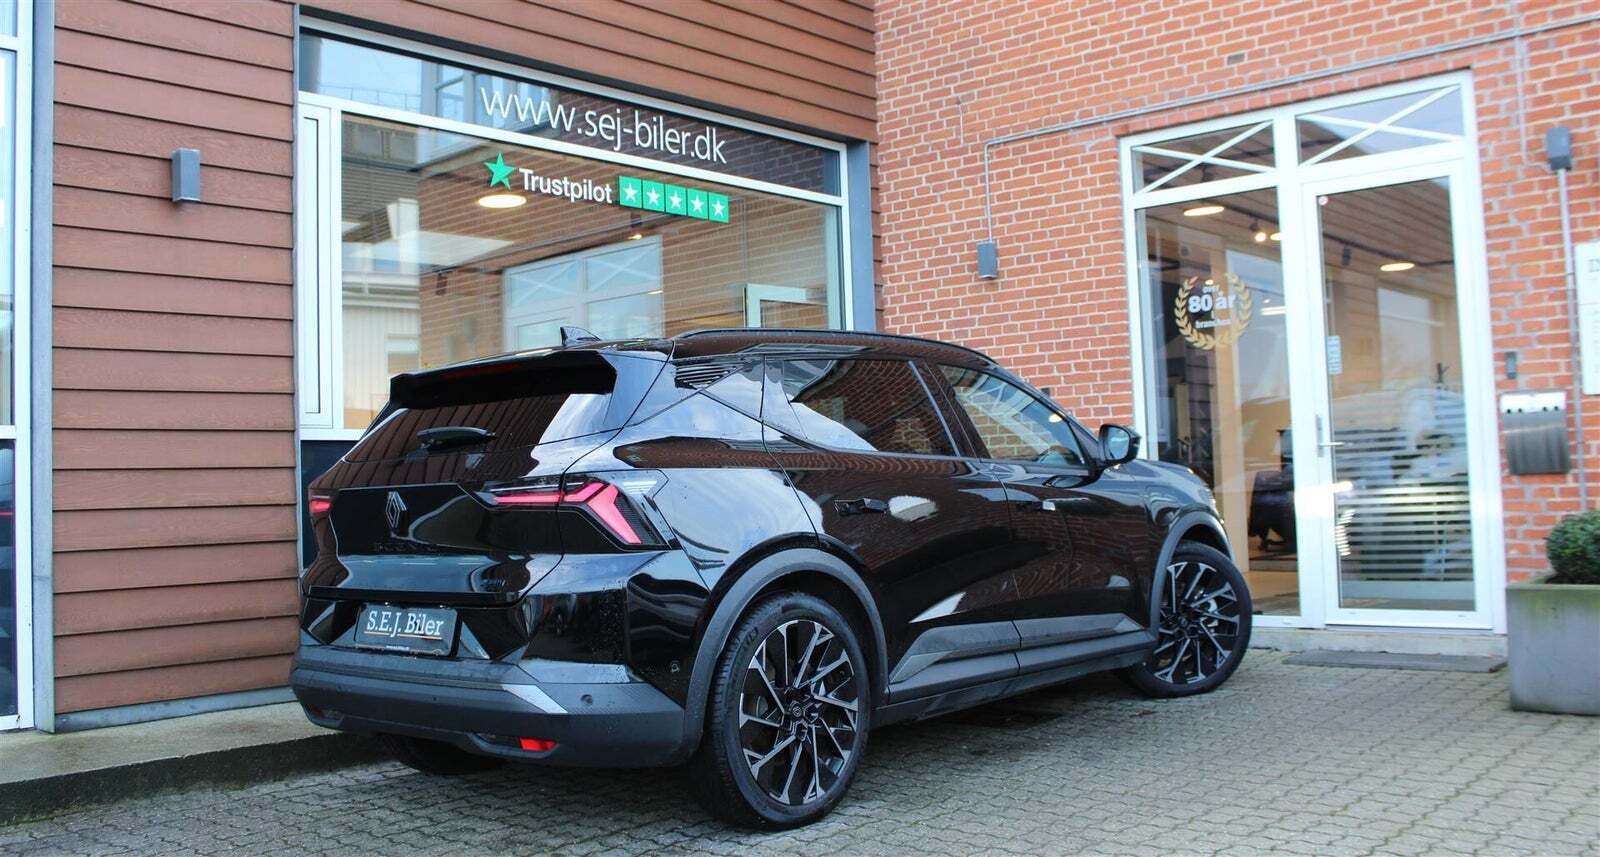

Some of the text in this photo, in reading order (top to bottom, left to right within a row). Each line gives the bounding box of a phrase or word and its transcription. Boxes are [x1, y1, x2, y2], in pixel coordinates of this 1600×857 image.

[480, 87, 728, 164] www.sej-biler.dk
[518, 168, 613, 204] Trustpilot
[1188, 294, 1213, 312] 80
[367, 610, 444, 638] S.E.J. Biler
